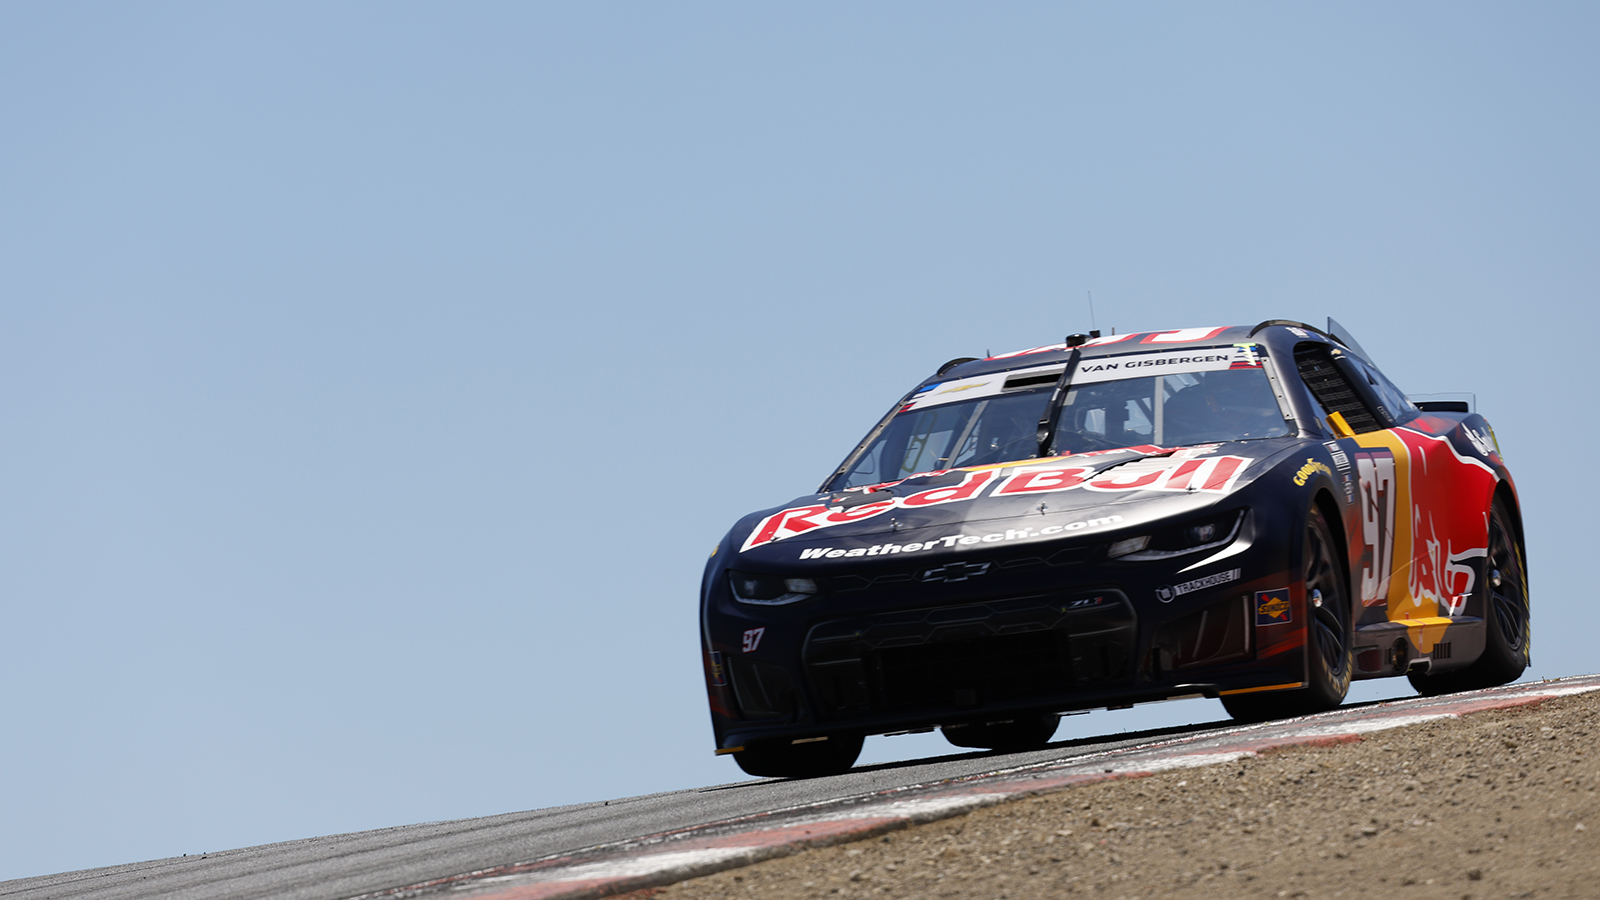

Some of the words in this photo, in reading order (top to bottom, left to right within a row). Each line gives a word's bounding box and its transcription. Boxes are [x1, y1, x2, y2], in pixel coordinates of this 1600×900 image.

[1081, 362, 1119, 374] VAN
[1125, 354, 1229, 369] GISBERGEN
[739, 468, 1004, 555] Red
[988, 455, 1255, 498] Bull
[798, 515, 1125, 561] WeatherTech.com
[1354, 452, 1397, 608] 97
[1177, 571, 1232, 594] TRACKHOUSE
[742, 626, 766, 654] 97
